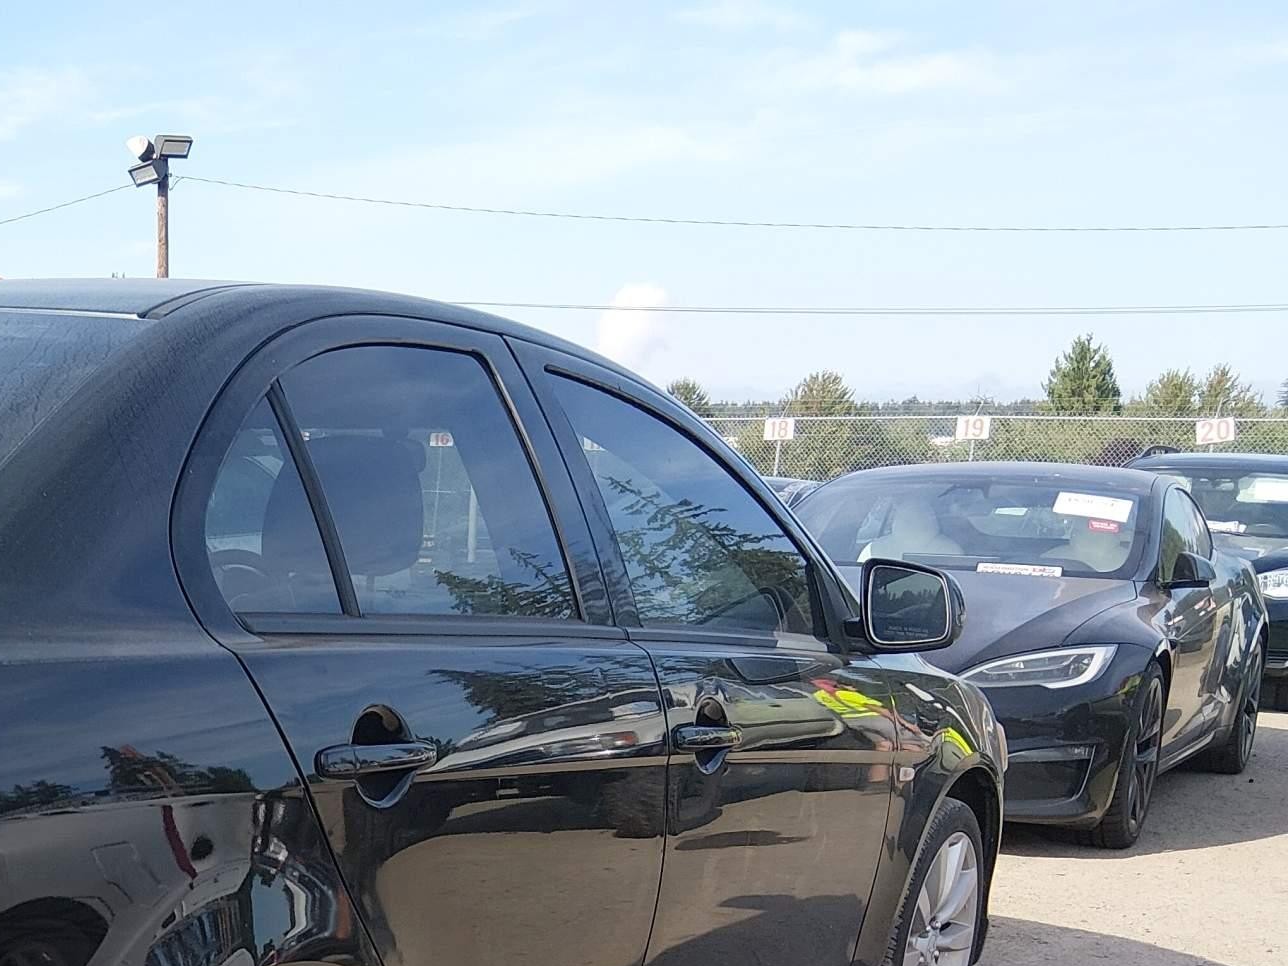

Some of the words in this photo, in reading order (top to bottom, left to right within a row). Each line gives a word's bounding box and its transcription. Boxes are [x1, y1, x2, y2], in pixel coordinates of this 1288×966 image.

[770, 420, 789, 439] 18
[963, 418, 985, 438] 19
[1200, 419, 1230, 443] 20
[434, 432, 451, 446] 16
